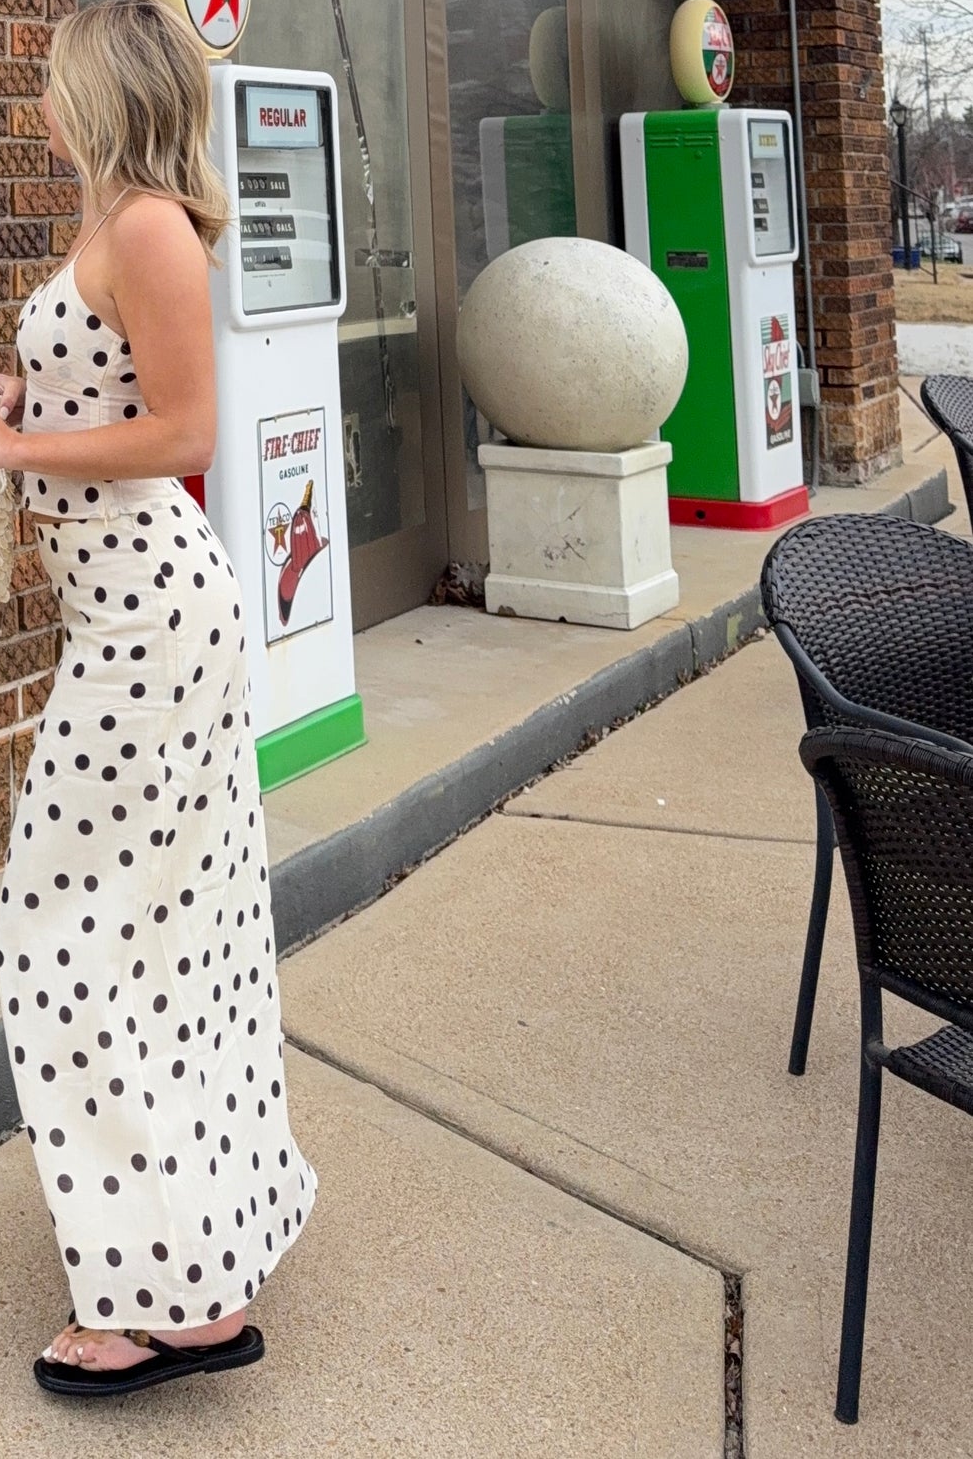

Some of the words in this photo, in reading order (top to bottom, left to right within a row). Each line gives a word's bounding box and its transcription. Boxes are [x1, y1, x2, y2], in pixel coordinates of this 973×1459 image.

[259, 107, 307, 128] REGULAR
[270, 181, 286, 190] SALE
[263, 427, 321, 462] FIRE-CHIEF
[279, 464, 308, 480] GASOLINE
[269, 513, 290, 526] TEXACO
